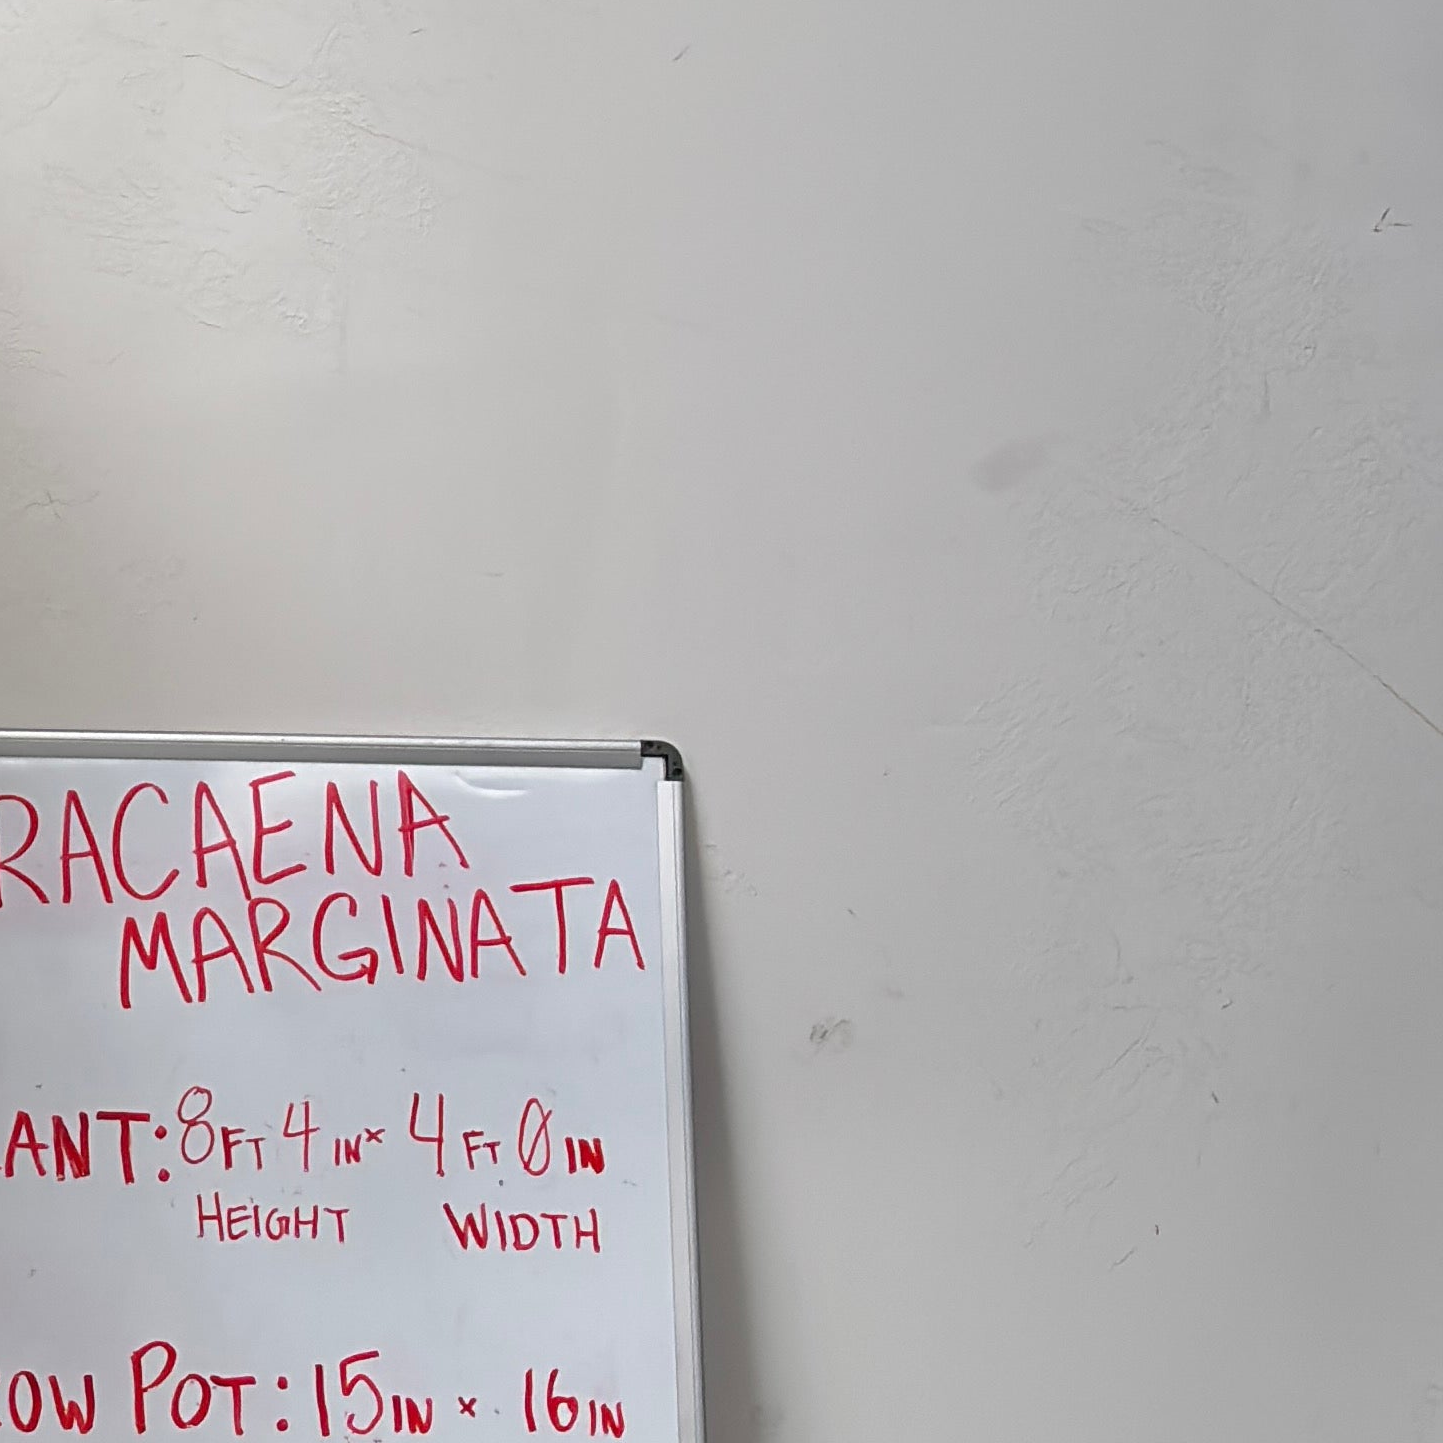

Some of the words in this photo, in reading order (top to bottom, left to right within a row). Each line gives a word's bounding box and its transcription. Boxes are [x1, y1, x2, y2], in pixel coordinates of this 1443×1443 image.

[118, 876, 646, 1011] MARGINATA
[195, 1193, 351, 1244] HEIGHT
[442, 1203, 601, 1254] WIDTH
[129, 1339, 290, 1438] POT:
